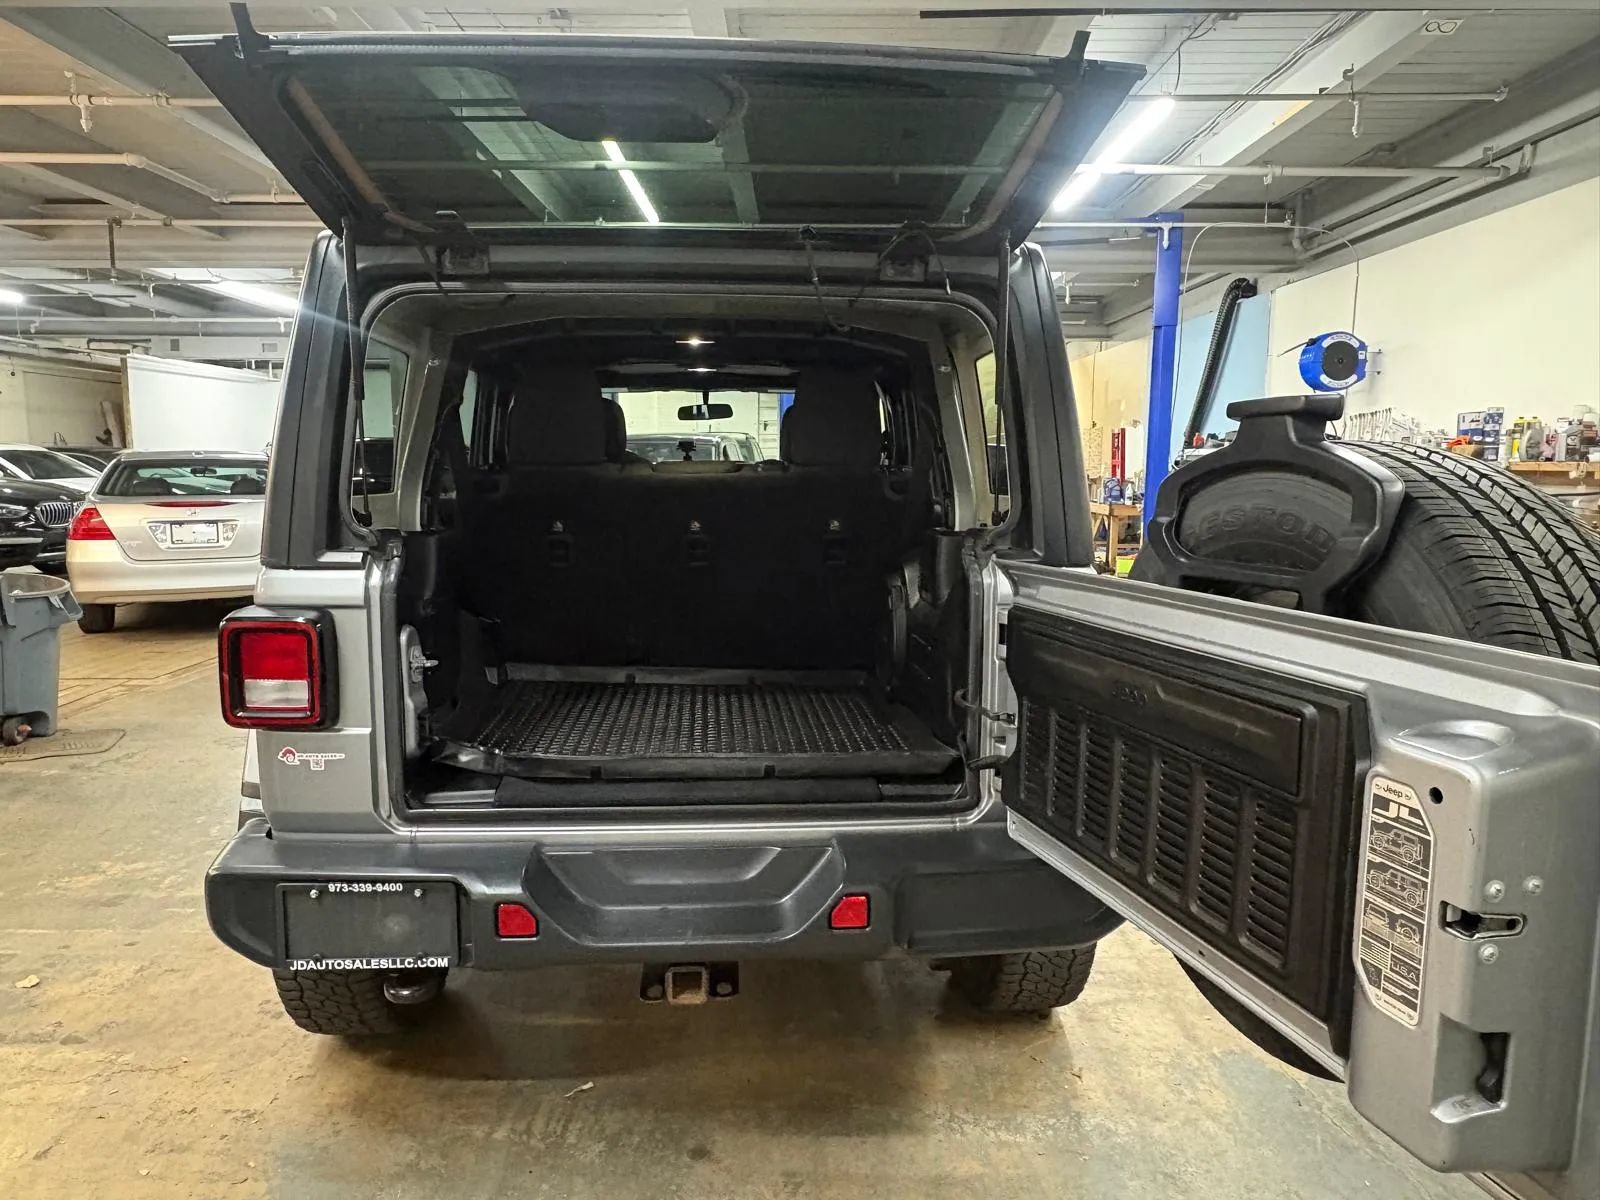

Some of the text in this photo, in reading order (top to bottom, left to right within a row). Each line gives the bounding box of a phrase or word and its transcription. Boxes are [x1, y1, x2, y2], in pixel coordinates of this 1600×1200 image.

[1382, 784, 1403, 798] Jeep
[1373, 801, 1424, 825] JL
[328, 882, 403, 892] 973-339-9400
[290, 957, 449, 971] JDAUTOSALESLLC.COM
